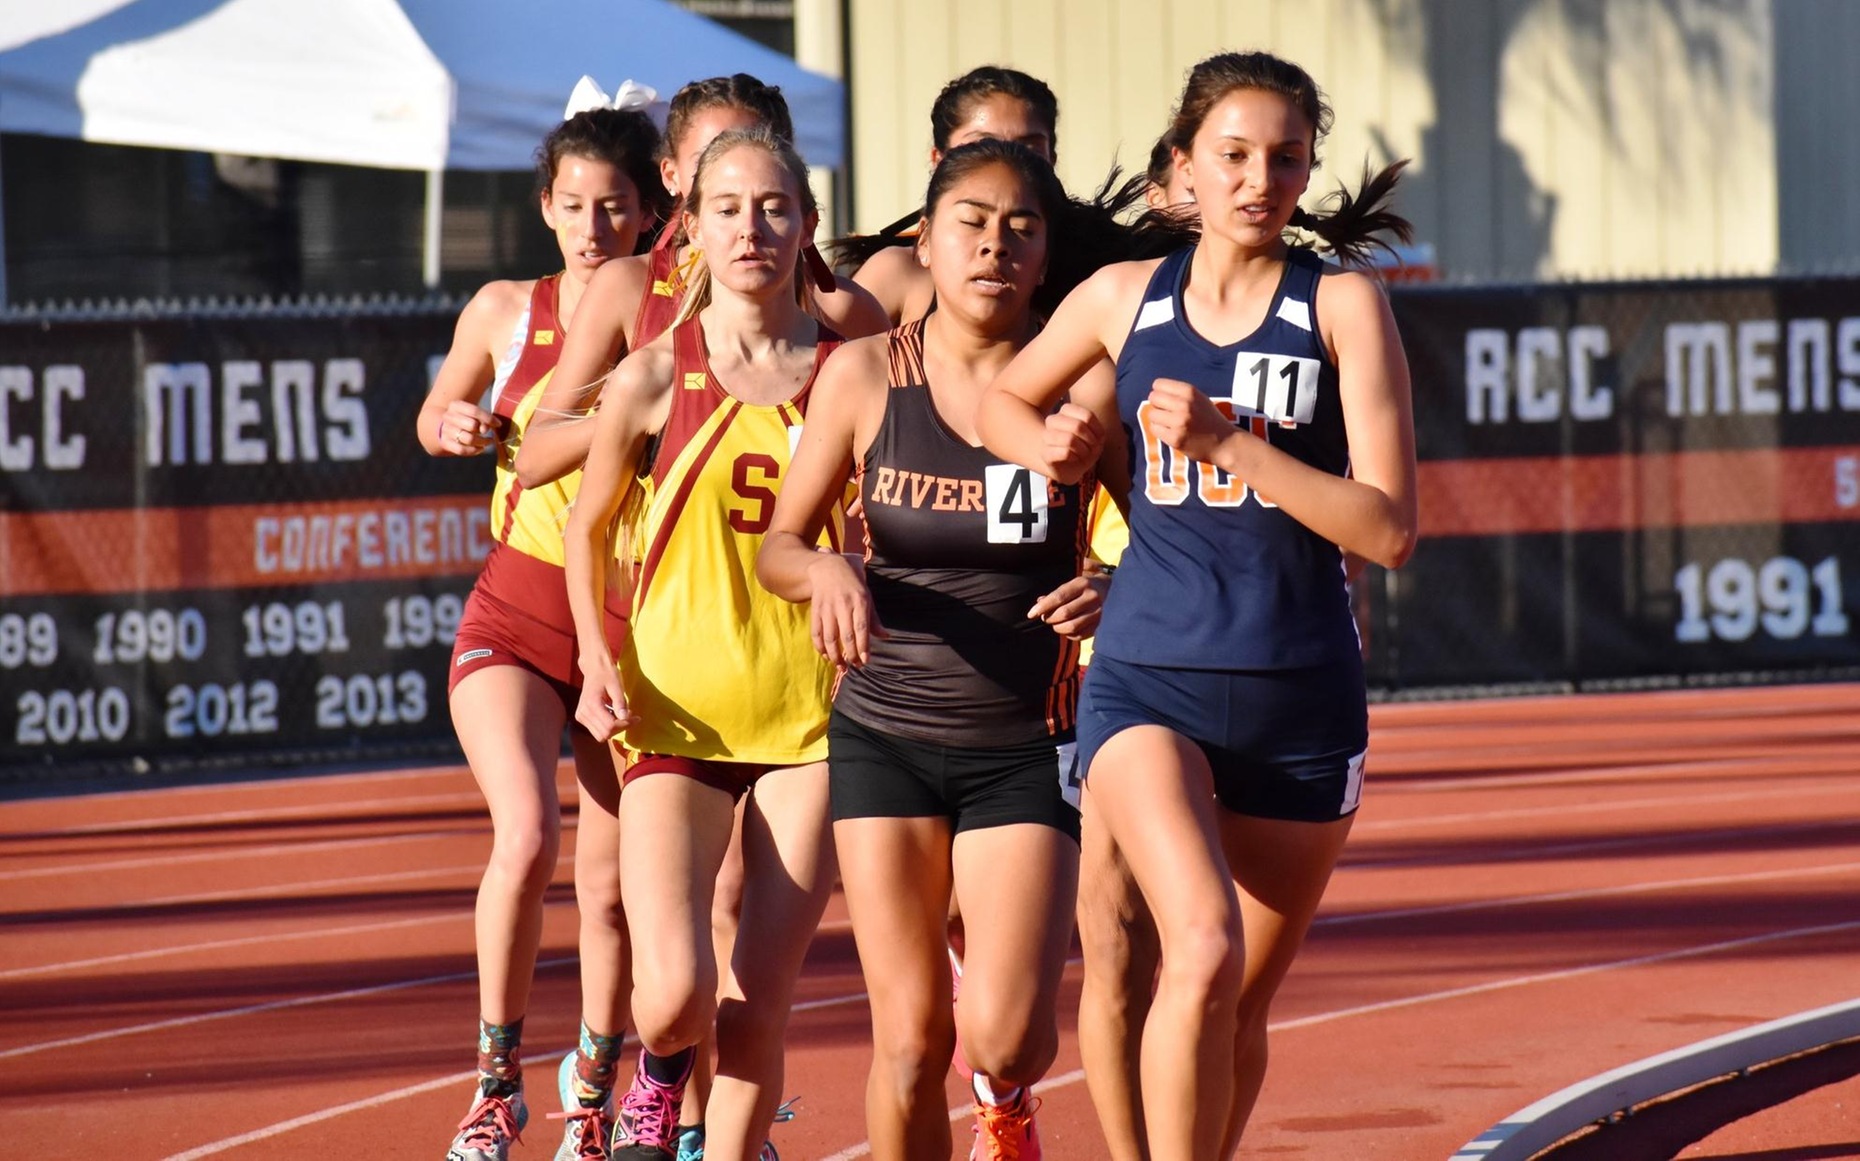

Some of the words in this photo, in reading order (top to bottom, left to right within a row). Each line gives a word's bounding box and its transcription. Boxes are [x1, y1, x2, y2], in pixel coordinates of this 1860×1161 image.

[1249, 357, 1300, 418] 11
[1664, 317, 1860, 418] MENS
[145, 359, 370, 466] MENS
[729, 452, 780, 535] S
[999, 468, 1039, 539] 4
[94, 608, 207, 664] 1990
[242, 602, 349, 657] 1991
[1674, 557, 1849, 642] 1991
[16, 686, 130, 745] 2010
[165, 680, 279, 737] 2012
[316, 670, 428, 729] 2013
